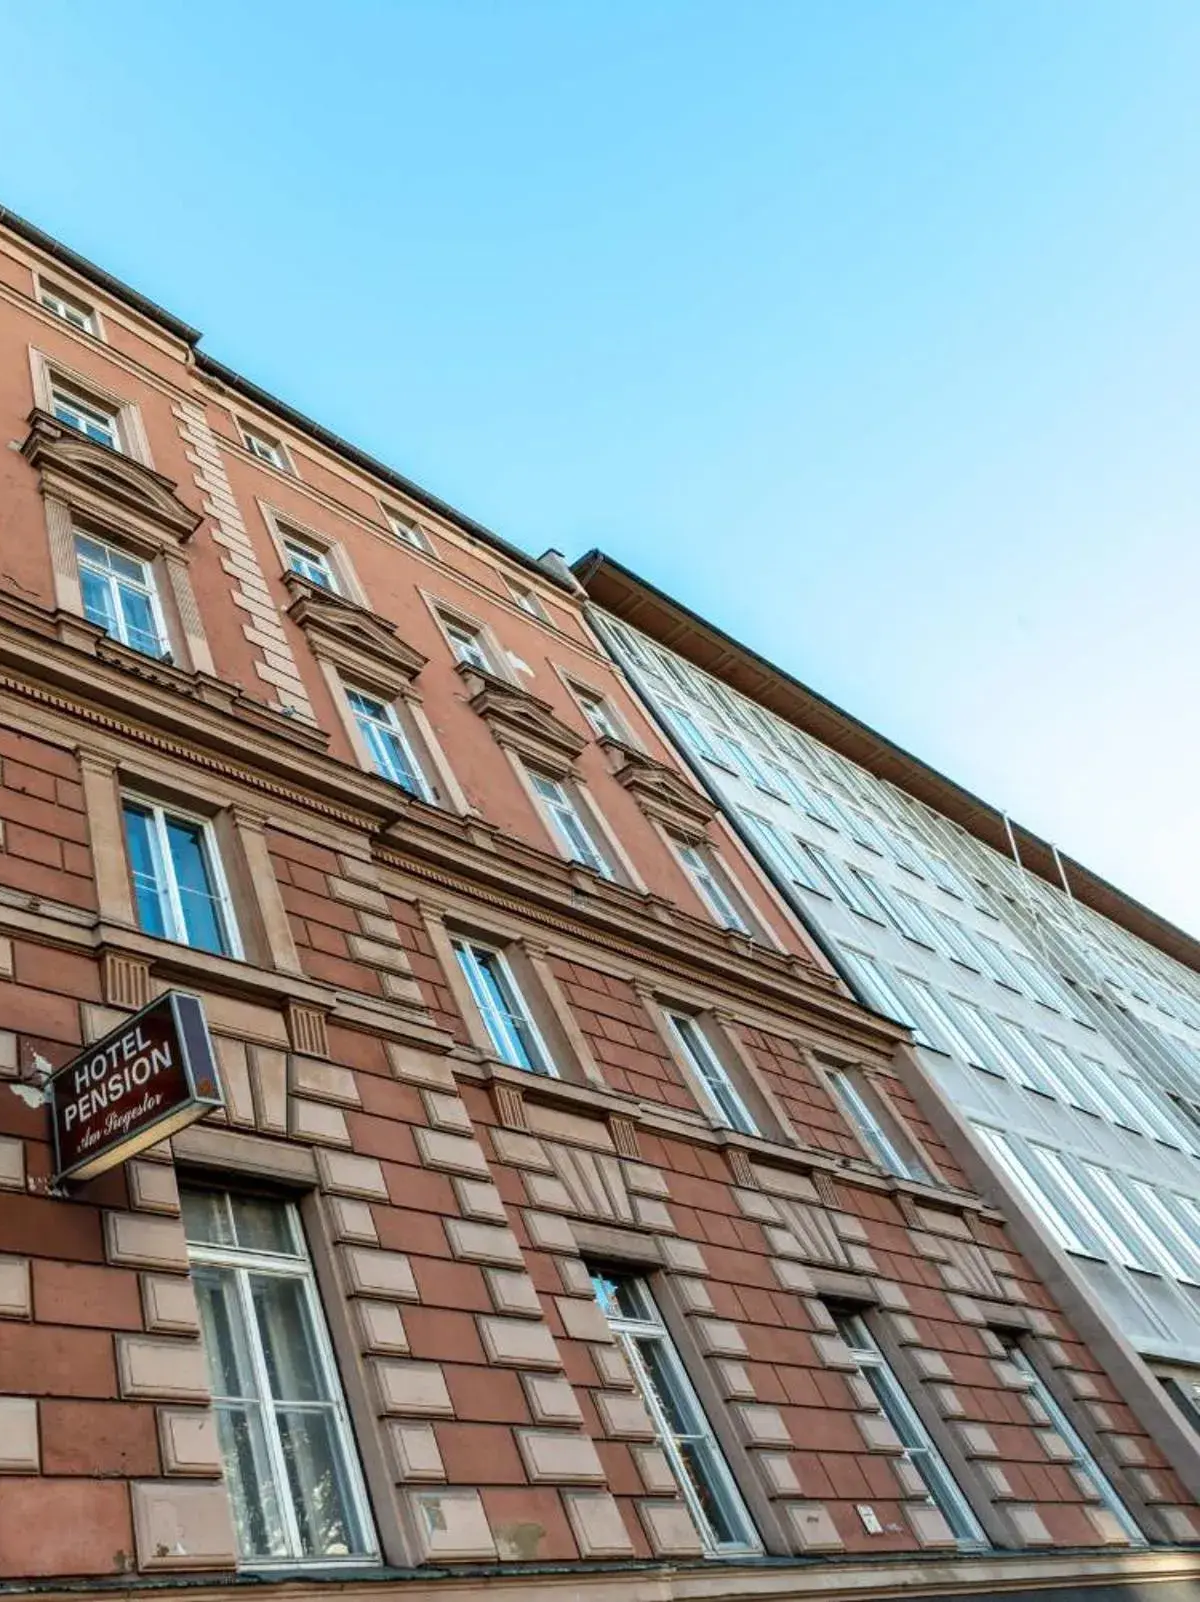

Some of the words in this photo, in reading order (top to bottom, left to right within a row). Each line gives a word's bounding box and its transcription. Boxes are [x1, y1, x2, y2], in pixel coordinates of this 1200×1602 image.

[64, 1041, 173, 1132] PENSION
[74, 1026, 152, 1094] HOTEL
[77, 1126, 103, 1153] Am
